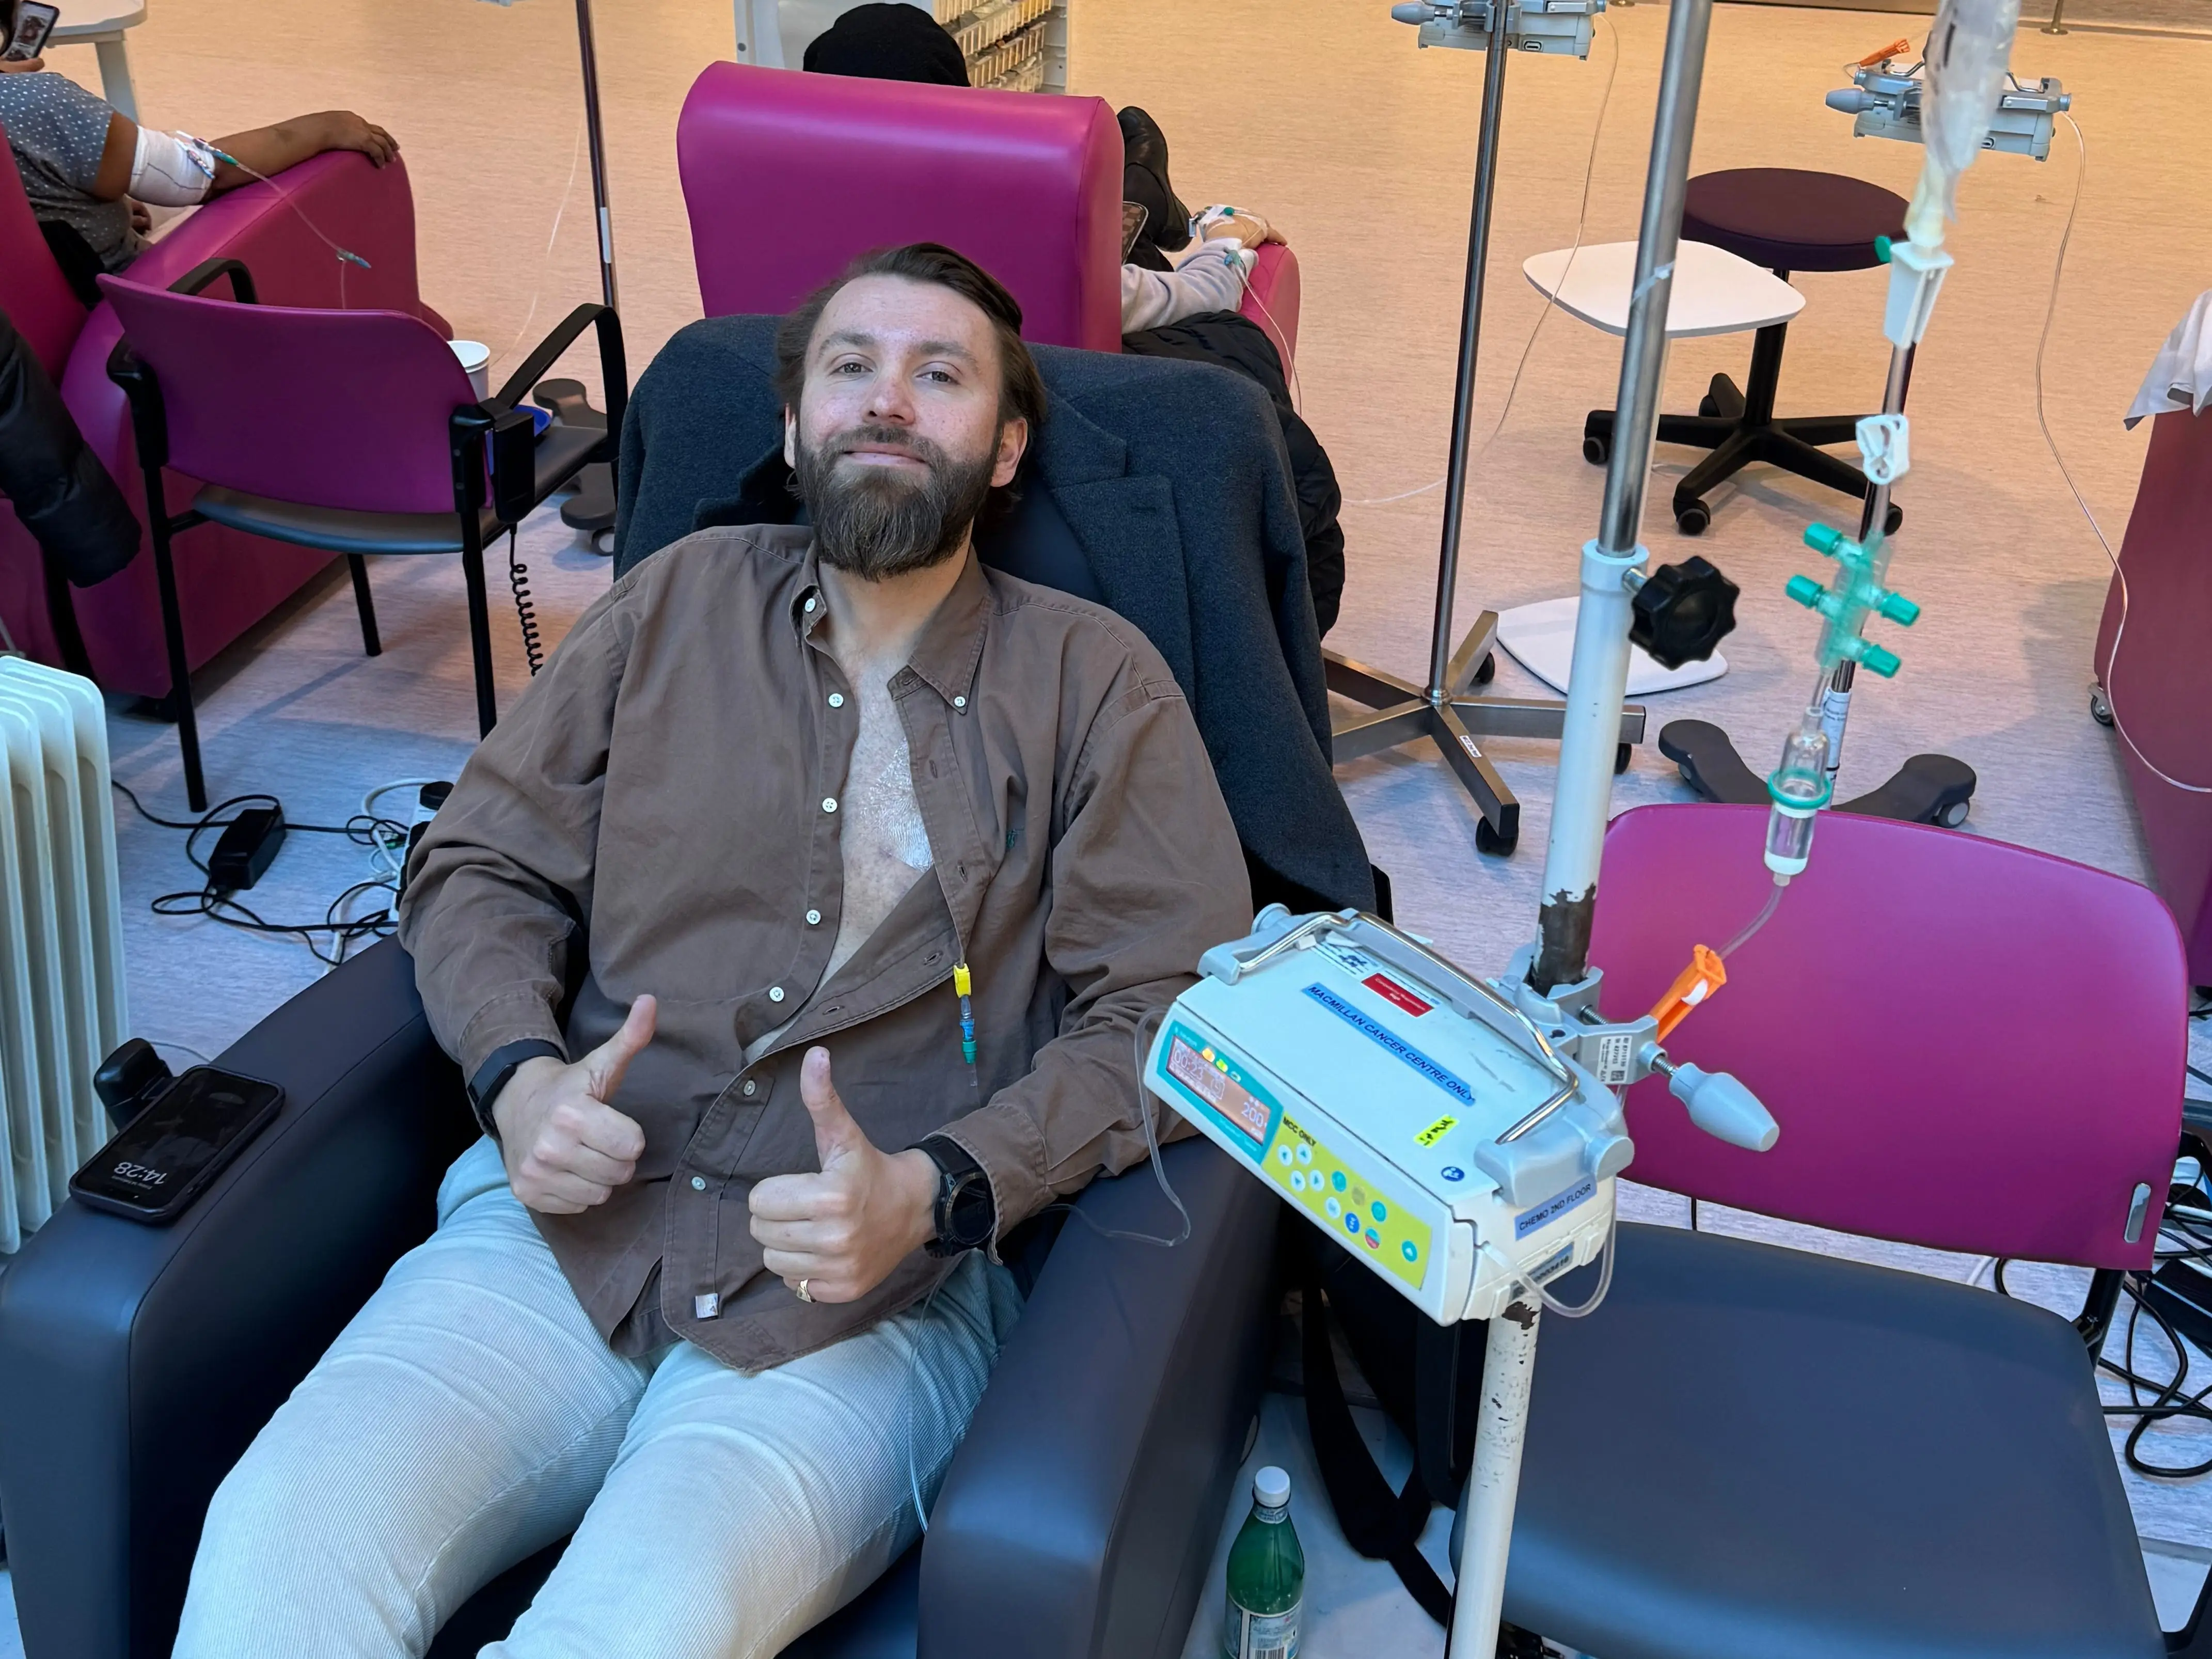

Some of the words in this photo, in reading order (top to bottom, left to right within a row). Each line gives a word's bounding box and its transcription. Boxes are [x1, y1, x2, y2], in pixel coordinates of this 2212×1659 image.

[1308, 986, 1366, 1025] MACMILLAN
[1364, 1024, 1407, 1054] CANCER
[1405, 1052, 1448, 1082] CENTRE
[1446, 1081, 1476, 1100] ONLY
[1174, 1050, 1204, 1080] 00:23
[1241, 1101, 1263, 1128] 200
[1283, 1116, 1298, 1133] MCC
[1299, 1129, 1316, 1146] ONLY
[114, 1162, 167, 1184] 14:28
[1519, 1209, 1549, 1231] CHEMO
[1551, 1199, 1566, 1214] 2ND
[1566, 1183, 1591, 1204] FLOOR
